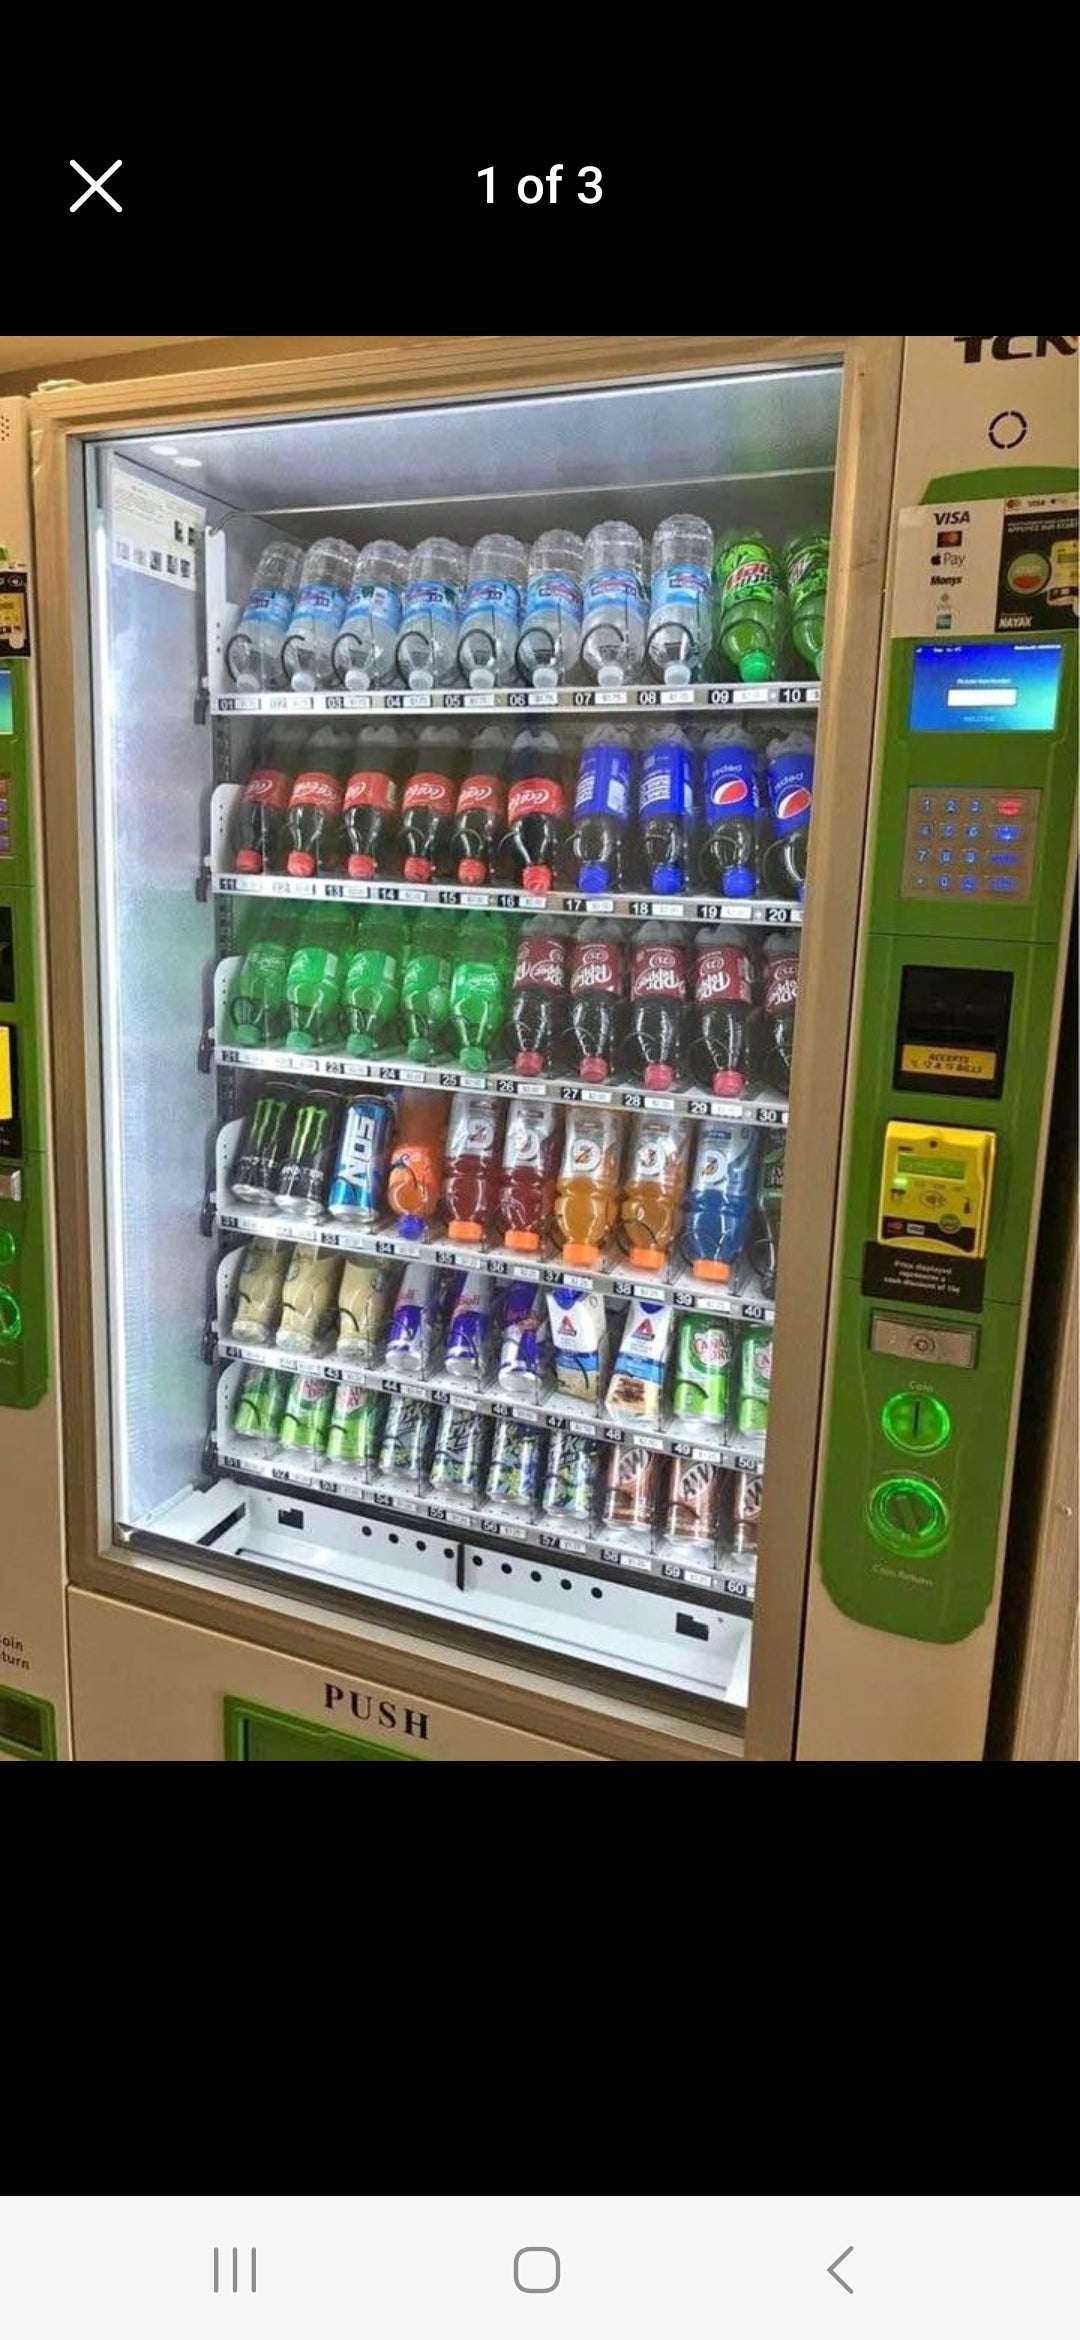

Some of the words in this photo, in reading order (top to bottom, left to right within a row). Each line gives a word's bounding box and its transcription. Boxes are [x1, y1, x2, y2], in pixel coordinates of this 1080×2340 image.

[934, 511, 970, 525] VISA
[943, 553, 966, 567] Pay
[998, 616, 1033, 629] NAYAX
[386, 695, 400, 706] 04
[445, 695, 460, 706] 05
[509, 694, 525, 706] 06
[575, 693, 591, 705] 07
[640, 692, 656, 704] 08
[712, 691, 729, 704] 09
[783, 690, 801, 702] 10
[327, 697, 342, 708] 03
[948, 800, 956, 811] 2
[919, 850, 927, 862] 7
[381, 888, 396, 899] 14
[441, 893, 457, 904] 15
[499, 896, 515, 907] 16
[565, 899, 582, 910] 17
[633, 903, 649, 914] 18
[700, 906, 718, 918] 19
[768, 909, 787, 921] 20
[380, 1067, 396, 1078] 24
[441, 1075, 457, 1086] 25
[499, 1081, 514, 1092] 26
[562, 1088, 579, 1100] 27
[624, 1095, 640, 1106] 28
[690, 1101, 707, 1113] 29
[758, 1109, 776, 1121] 30
[378, 1243, 392, 1253] 34
[438, 1252, 453, 1263] 35
[489, 1261, 505, 1272] 36
[546, 1271, 562, 1282] 37
[616, 1283, 631, 1294] 38
[676, 1294, 692, 1305] 39
[745, 1306, 761, 1318] 40
[383, 1381, 399, 1391] 44
[909, 1380, 934, 1393] Coin
[547, 1417, 563, 1428] 47
[605, 1429, 622, 1441] 48
[674, 1444, 690, 1456] 49
[738, 1458, 754, 1470] 50
[376, 1494, 392, 1505] 54
[429, 1506, 445, 1518] 55
[483, 1520, 499, 1532] 56
[541, 1535, 557, 1547] 57
[604, 1550, 619, 1562] 58
[664, 1565, 681, 1577] 59
[872, 1563, 898, 1578] Coin
[727, 1582, 744, 1595] 60
[0, 1636, 24, 1652] oin
[0, 1651, 30, 1671] turn
[324, 1683, 430, 1740] PUSH
